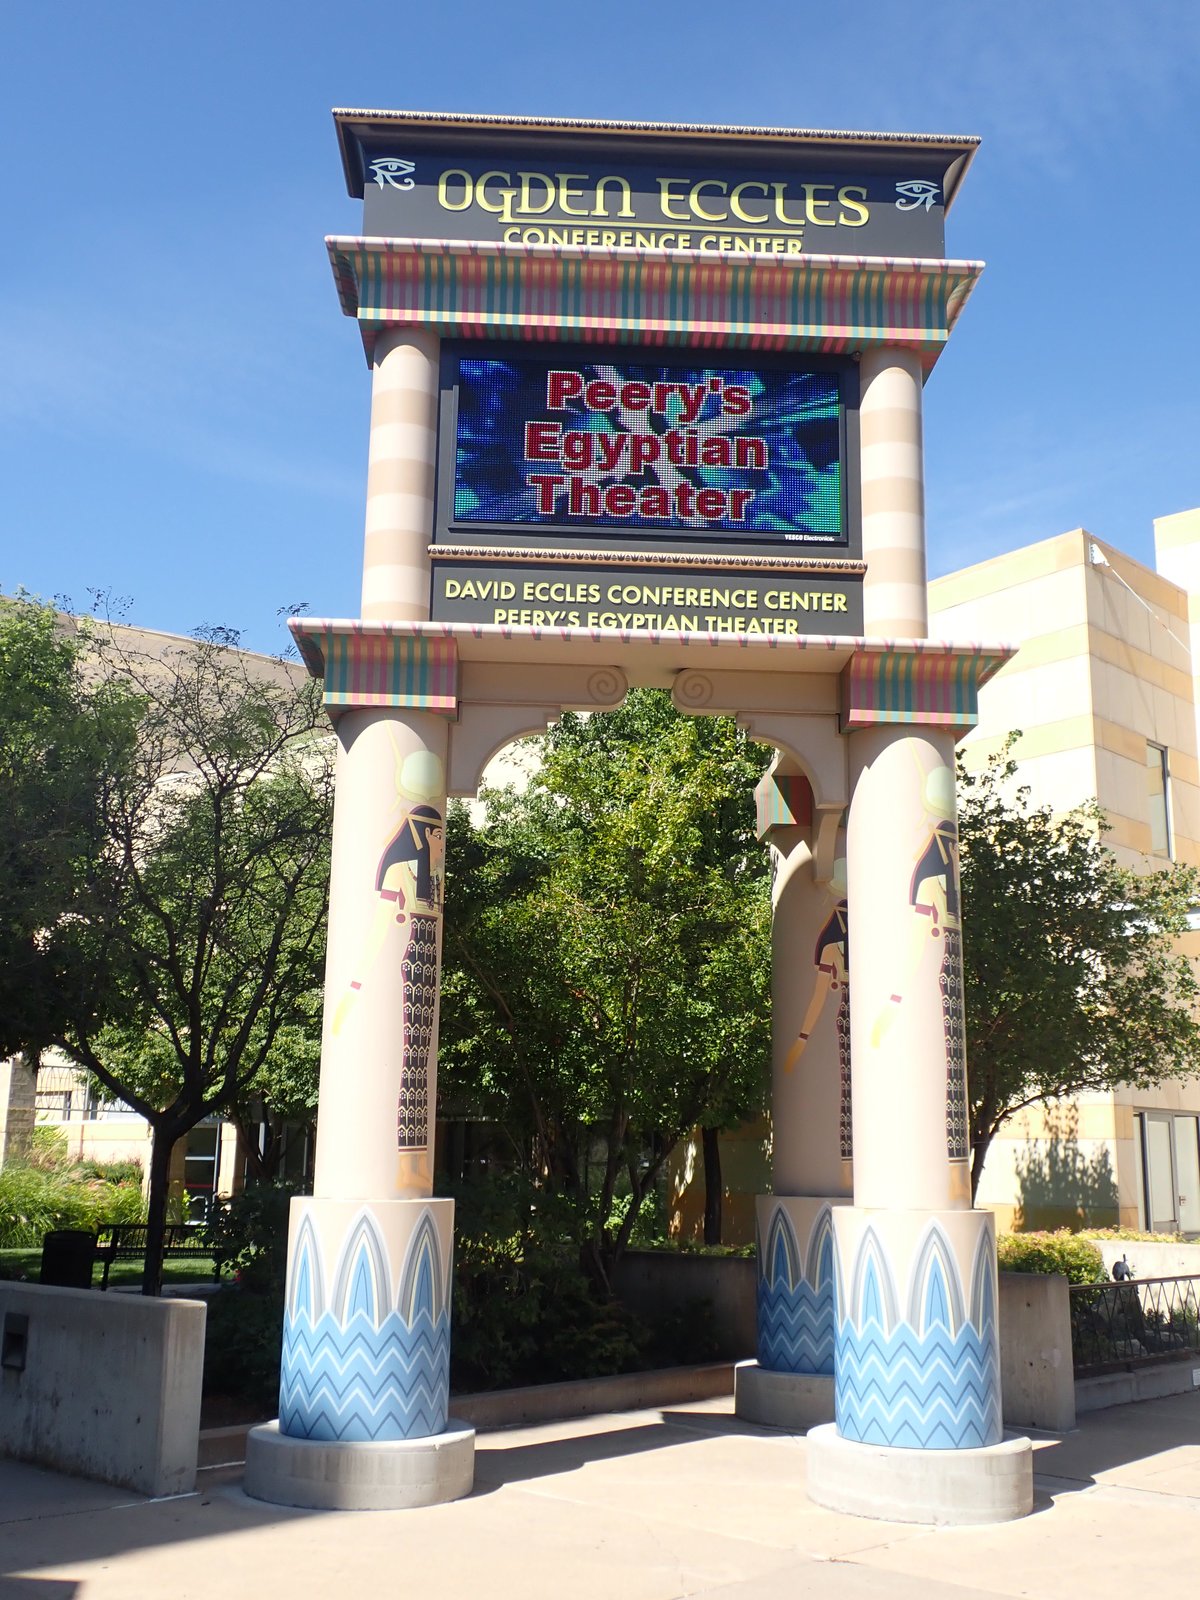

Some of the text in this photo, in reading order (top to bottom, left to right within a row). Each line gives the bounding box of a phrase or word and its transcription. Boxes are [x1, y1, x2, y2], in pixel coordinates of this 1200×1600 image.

[438, 169, 870, 227] OGDEN ECCLES
[504, 227, 803, 255] CONFERENCE CENTER
[546, 370, 752, 423] Peery's
[524, 421, 769, 474] Egyptian
[526, 473, 757, 522] Theater
[445, 579, 848, 613] DAVID ECCLES CONFERENCE CENTER
[587, 612, 698, 632] EGYPTIAN
[705, 616, 799, 636] THEATER
